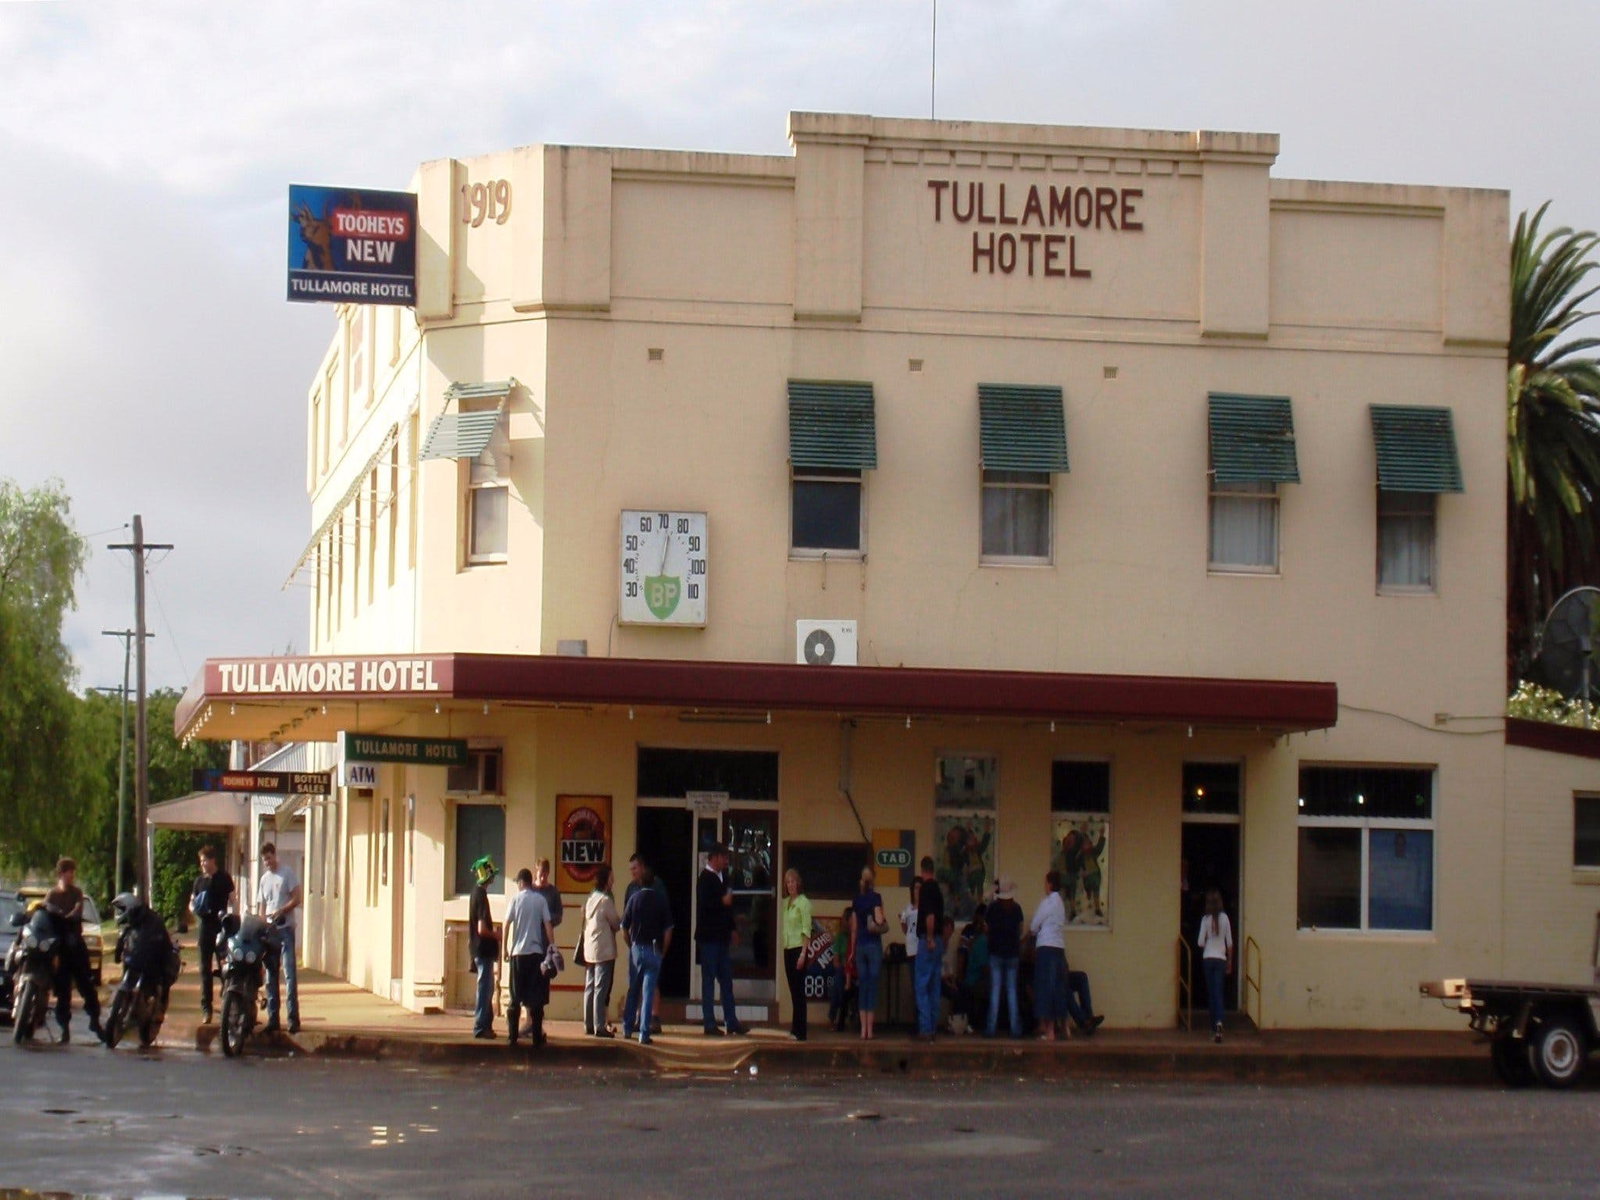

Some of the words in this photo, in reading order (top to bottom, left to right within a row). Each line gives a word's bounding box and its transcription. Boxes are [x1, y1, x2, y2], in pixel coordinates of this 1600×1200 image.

[462, 179, 512, 228] 1919
[928, 180, 1143, 231] TULLAMORE
[337, 212, 405, 235] TOOHEYS
[346, 238, 396, 264] NEW
[973, 231, 1091, 278] HOTEL
[291, 278, 368, 296] TULLAMORE
[370, 282, 412, 298] HOTEL
[640, 517, 652, 532] 60
[658, 514, 669, 529] 70
[677, 518, 689, 534] 80
[626, 535, 638, 551] 50
[689, 536, 700, 552] 90
[623, 558, 635, 574] 40
[691, 559, 706, 575] 100
[625, 582, 638, 597] 30
[652, 583, 677, 608] BP
[688, 584, 699, 599] 110
[218, 661, 355, 693] TULLAMORE
[361, 660, 439, 692] HOTEL
[355, 740, 419, 757] TULLAMORE
[425, 744, 458, 759] HOTEL
[257, 776, 279, 788] NEW
[294, 774, 328, 785] BOTTLE
[350, 766, 375, 783] ATM
[297, 784, 325, 793] SALES
[561, 840, 605, 862] NEW
[881, 852, 907, 864] TAB
[817, 945, 835, 969] NE
